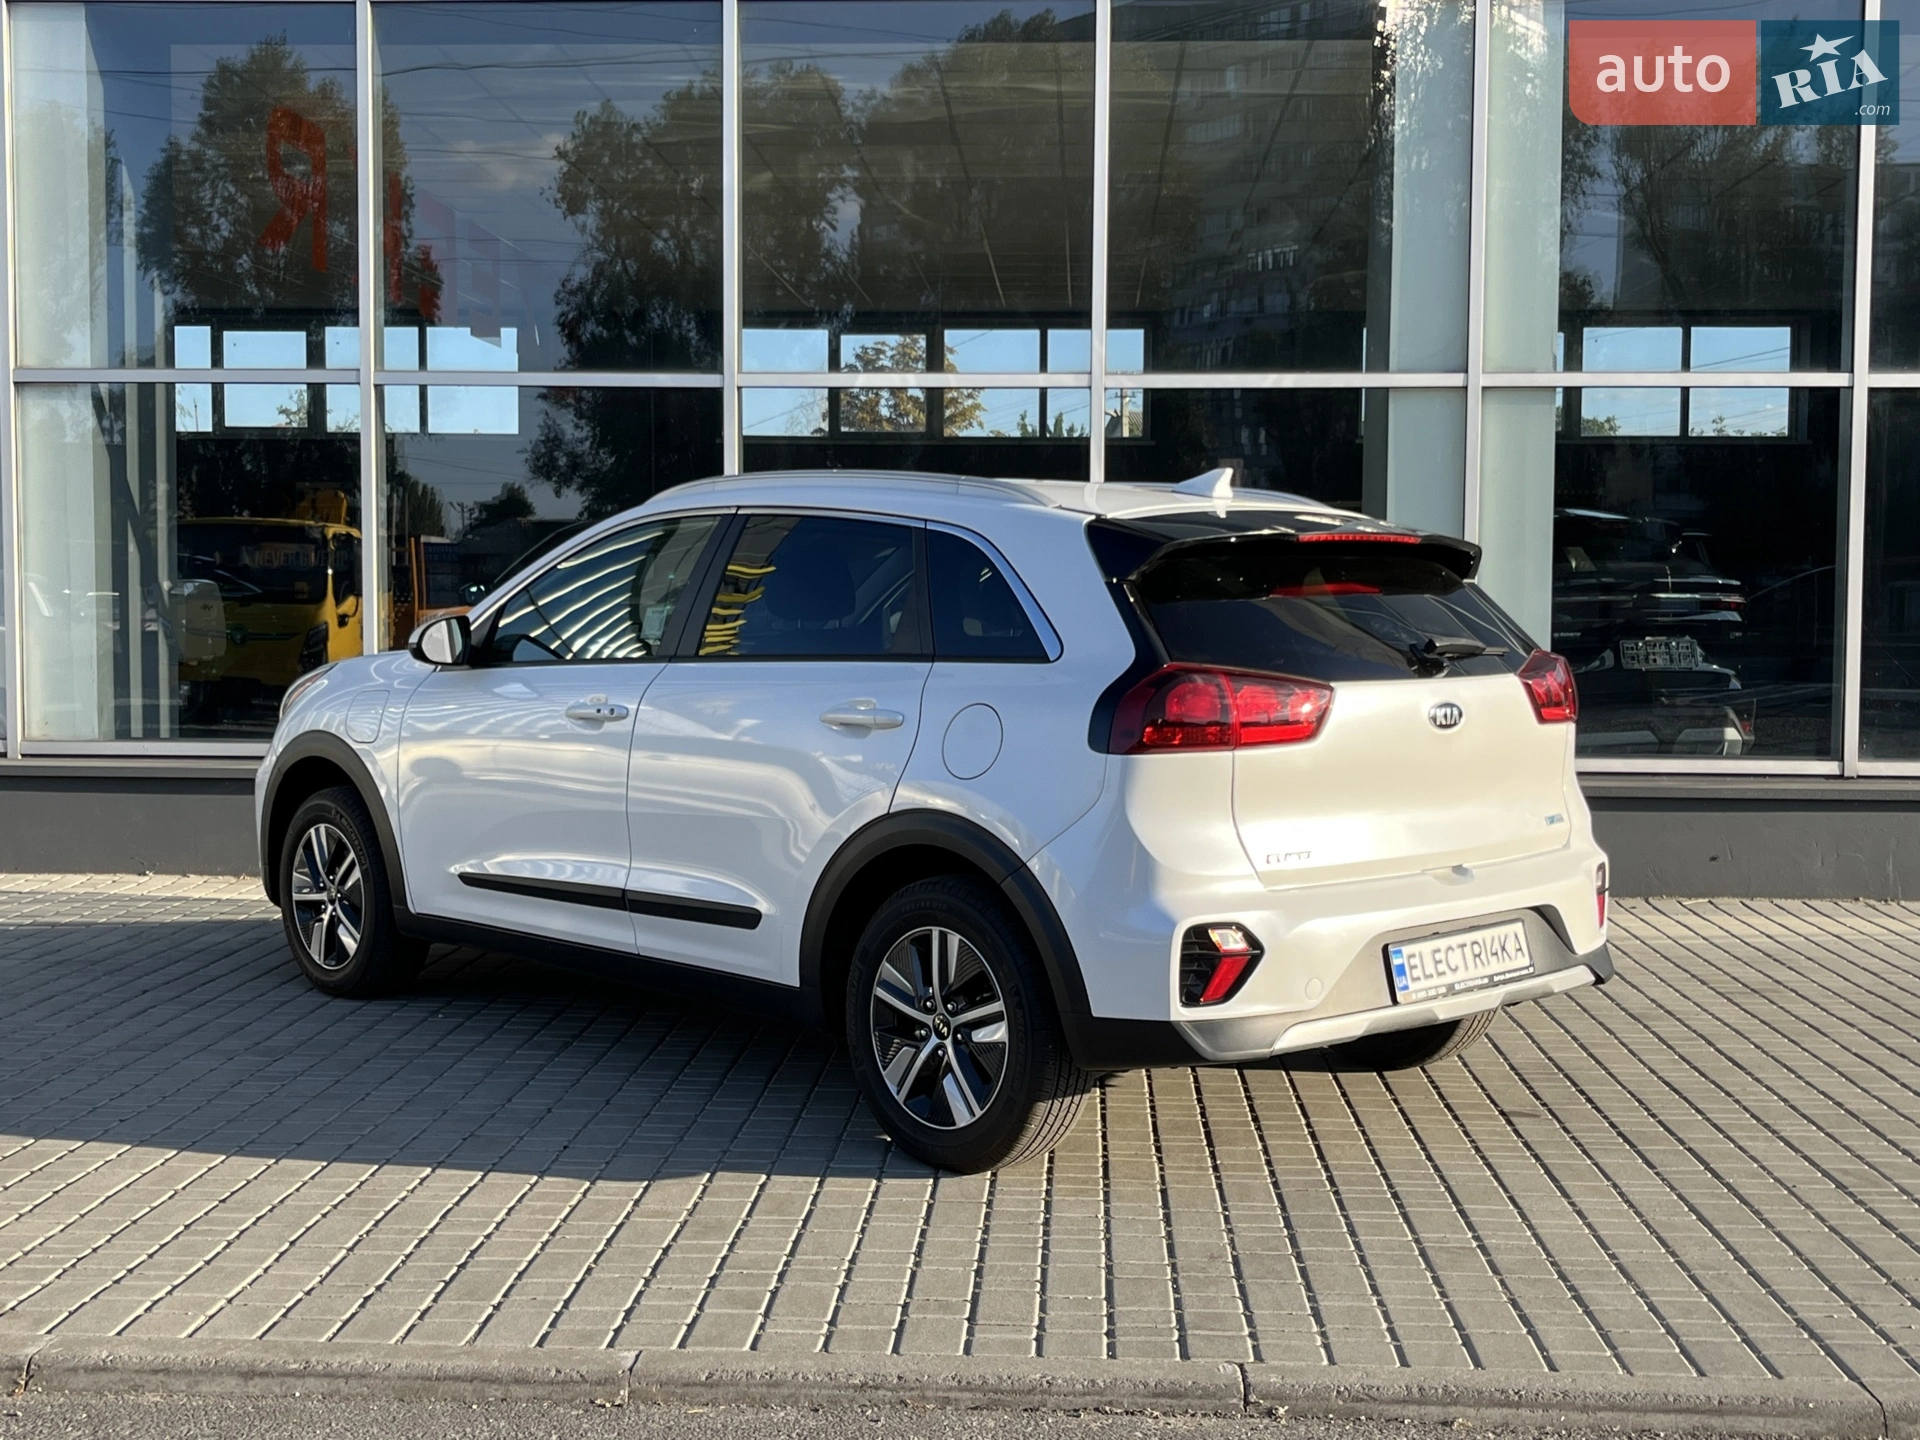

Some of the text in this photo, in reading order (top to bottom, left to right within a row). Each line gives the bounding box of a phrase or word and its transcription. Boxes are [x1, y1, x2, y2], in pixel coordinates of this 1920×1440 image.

[255, 549, 296, 567] NEVER
[1435, 706, 1460, 726] KIA
[1406, 931, 1526, 984] ELECTRI4KA
[1396, 976, 1408, 988] UA
